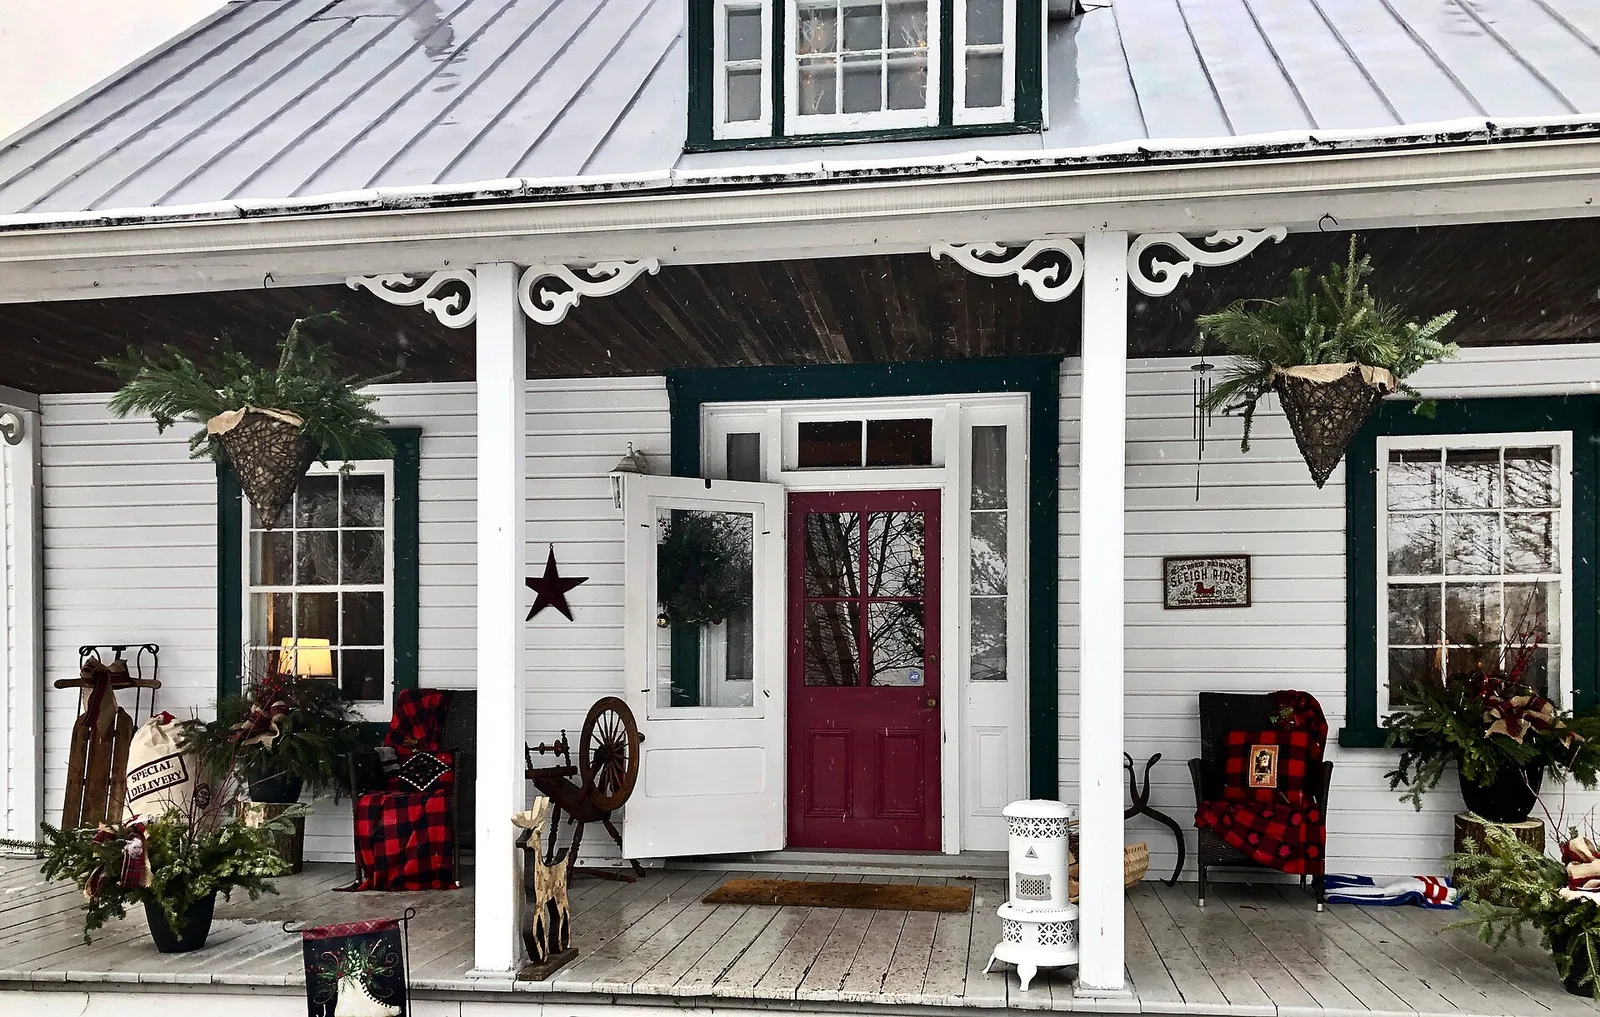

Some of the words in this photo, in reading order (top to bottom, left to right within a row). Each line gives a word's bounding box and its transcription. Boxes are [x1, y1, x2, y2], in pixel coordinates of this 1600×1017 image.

[1170, 569, 1207, 587] SLEIGH
[1212, 569, 1244, 586] RIDES
[131, 760, 174, 783] SPECIAL
[131, 771, 182, 797] DELIVERY
